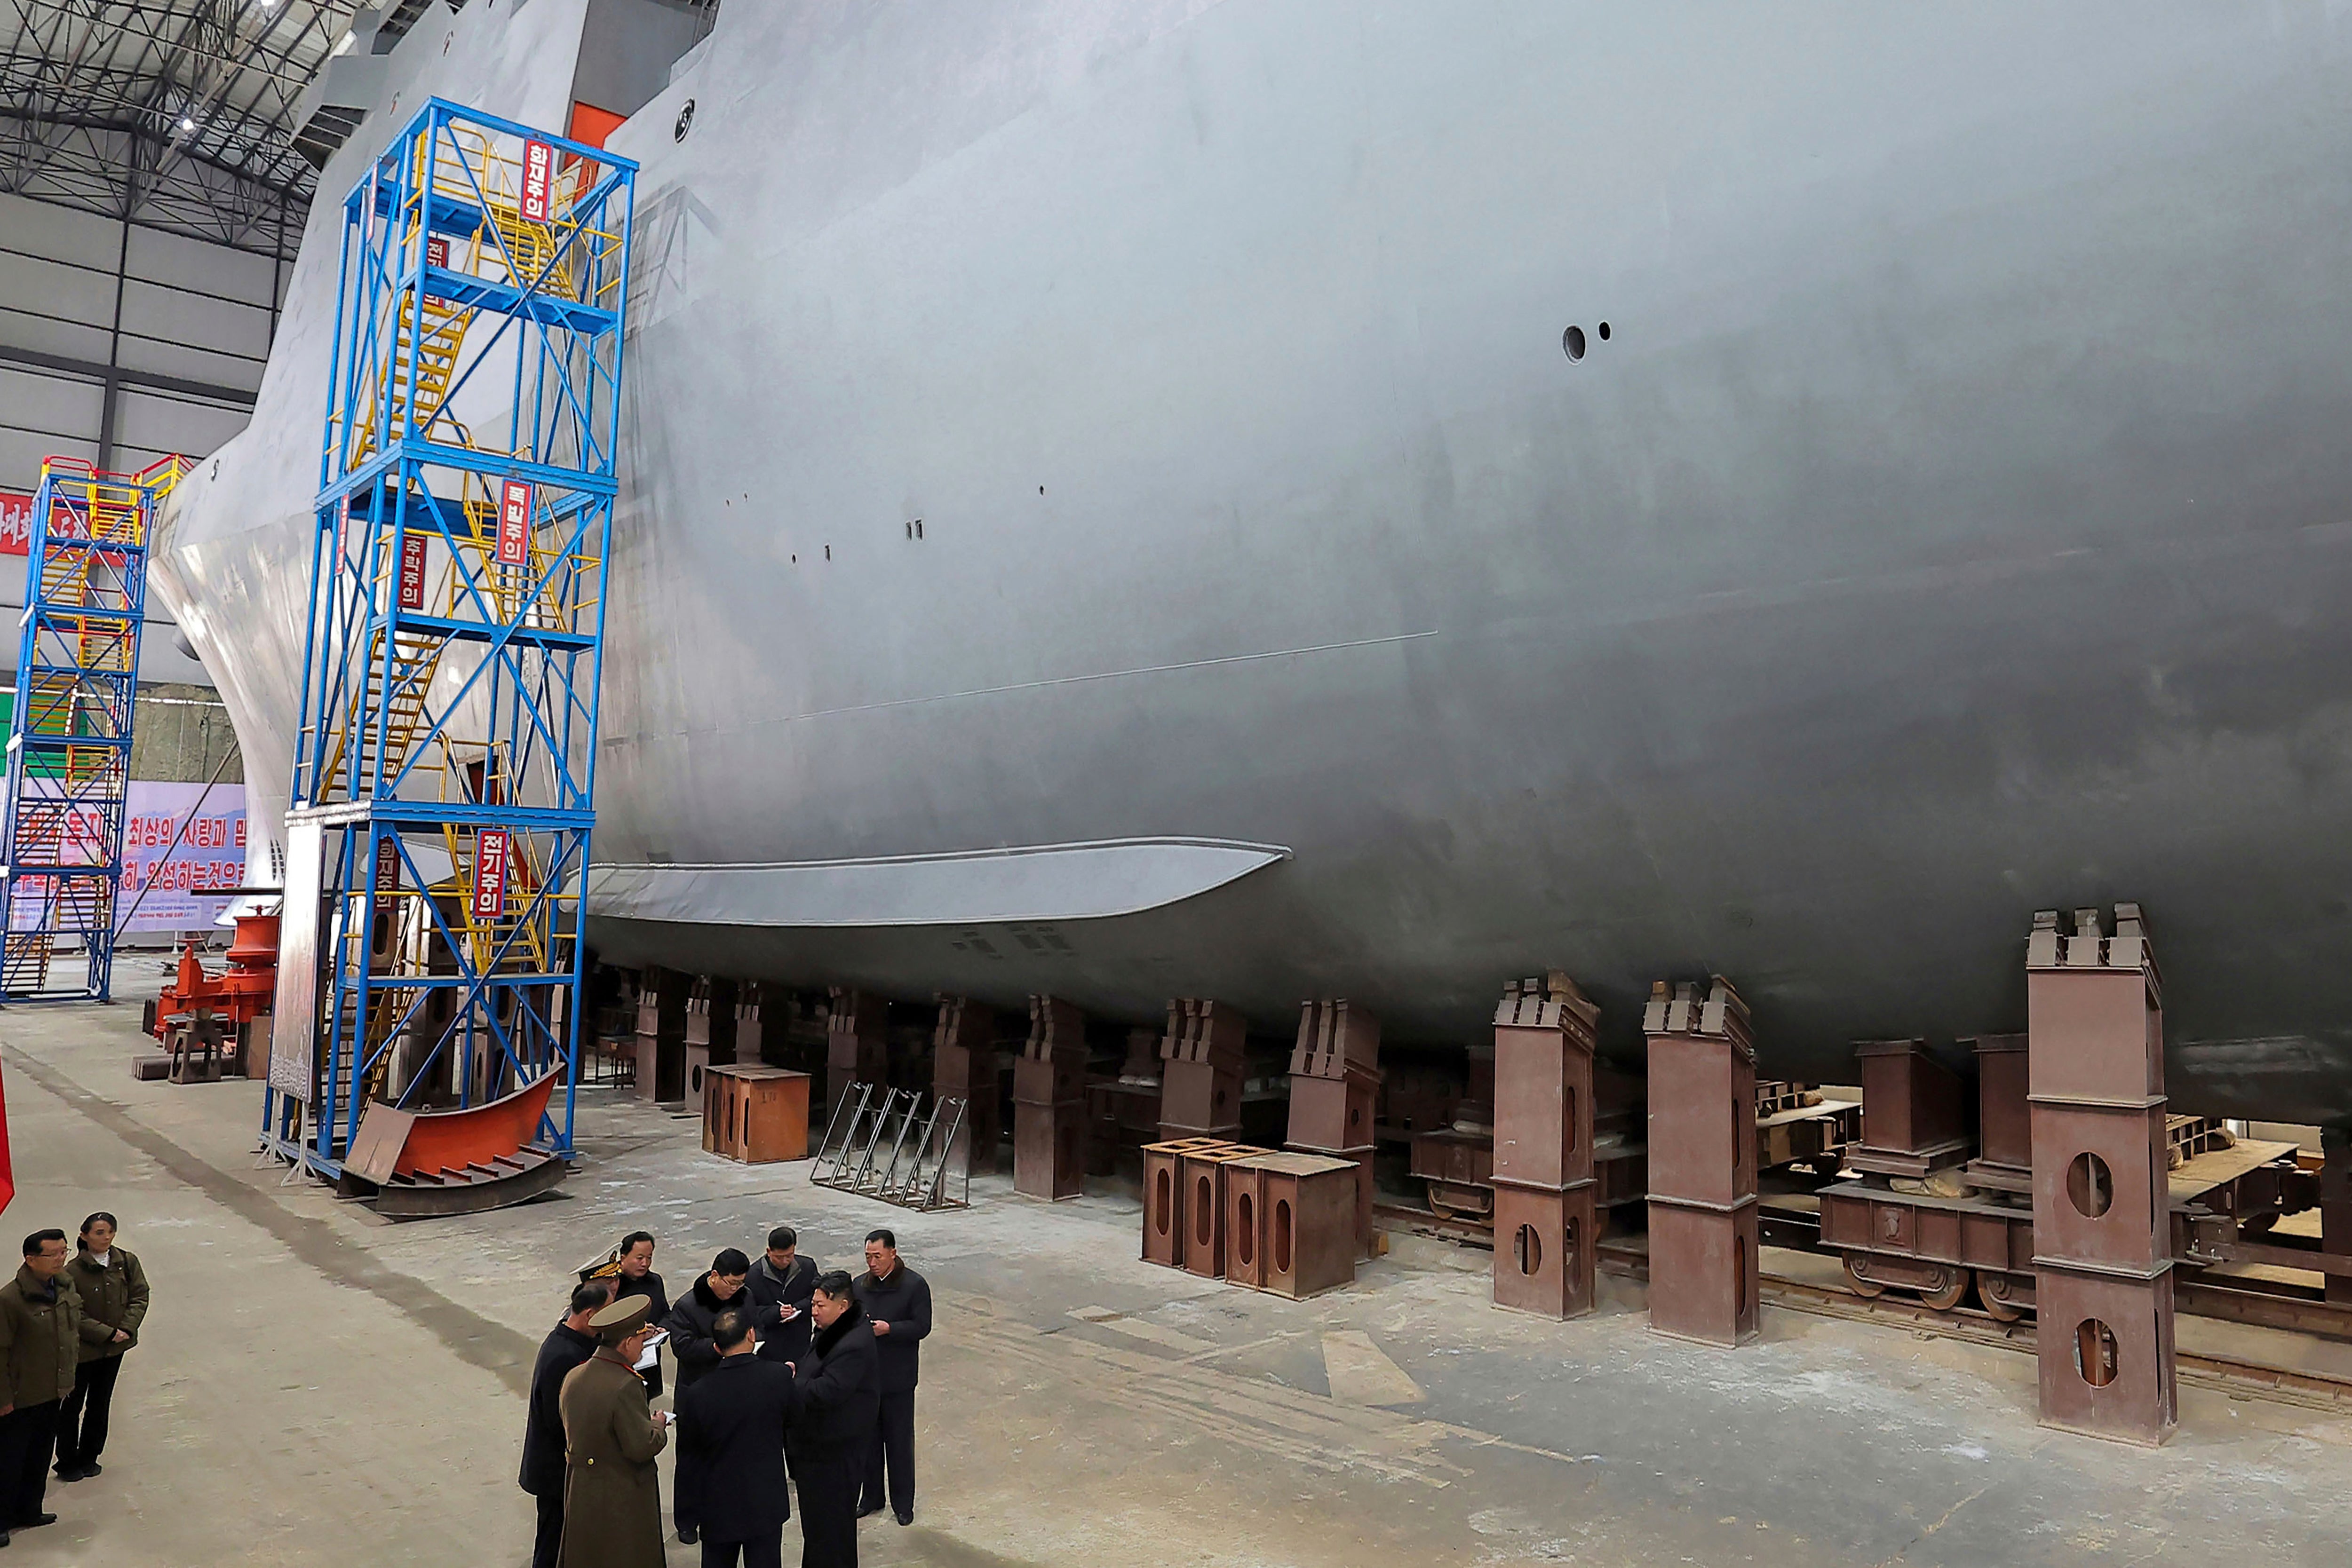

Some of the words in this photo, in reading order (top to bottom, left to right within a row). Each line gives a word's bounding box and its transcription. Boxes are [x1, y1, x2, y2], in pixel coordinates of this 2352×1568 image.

[525, 145, 548, 218] 화재주의
[504, 485, 526, 561] 폭발주의
[402, 539, 421, 603] 추락주의
[128, 817, 174, 846] 최상의
[183, 818, 227, 847] 사랑과
[478, 835, 502, 912] 전기주의
